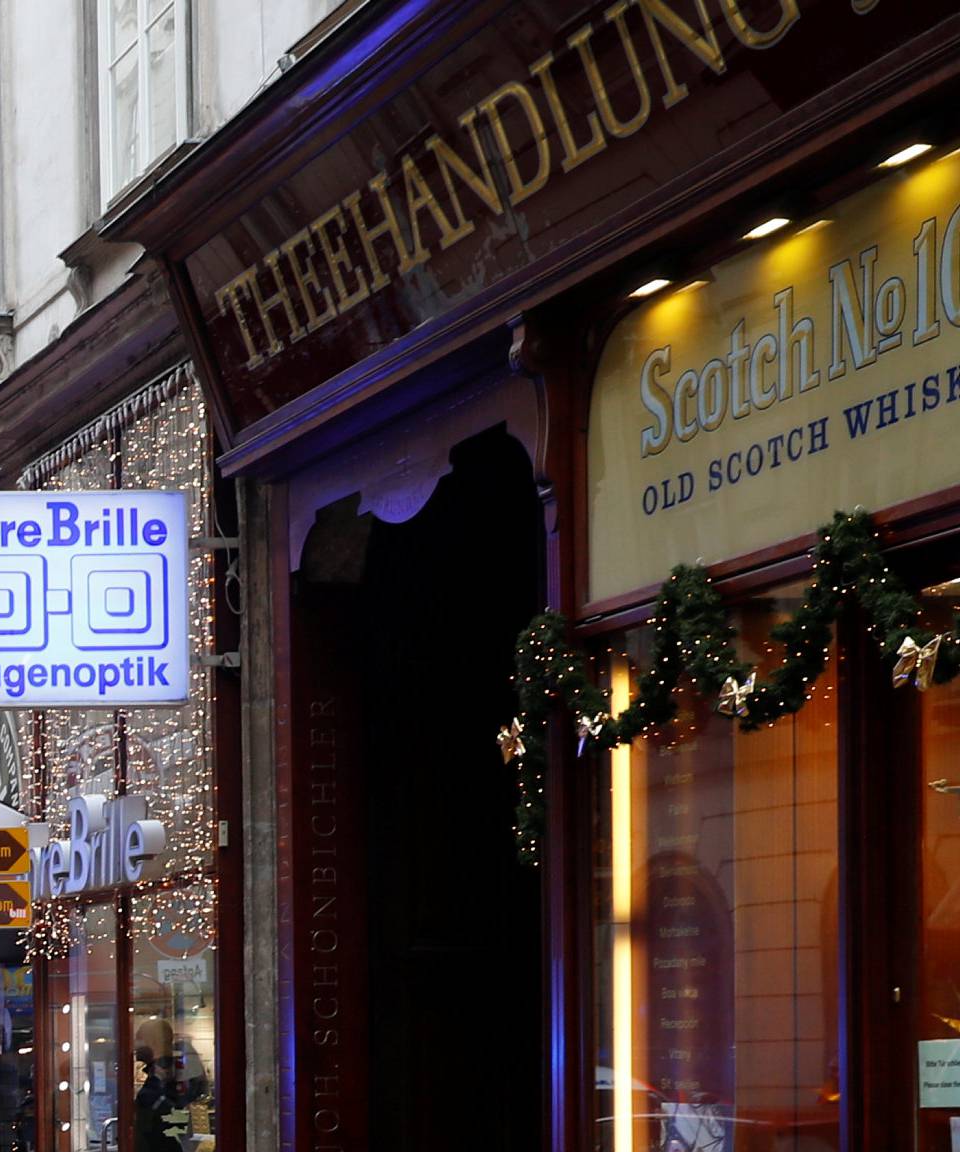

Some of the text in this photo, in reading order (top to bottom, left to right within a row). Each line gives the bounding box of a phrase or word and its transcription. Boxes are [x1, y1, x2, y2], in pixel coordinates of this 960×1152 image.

[640, 286, 820, 458] Scotch
[642, 472, 695, 515] OLD
[708, 416, 829, 491] SCOTCH
[0, 724, 19, 807] COMPAN
[308, 697, 339, 1047] SCHÖNBICHLER
